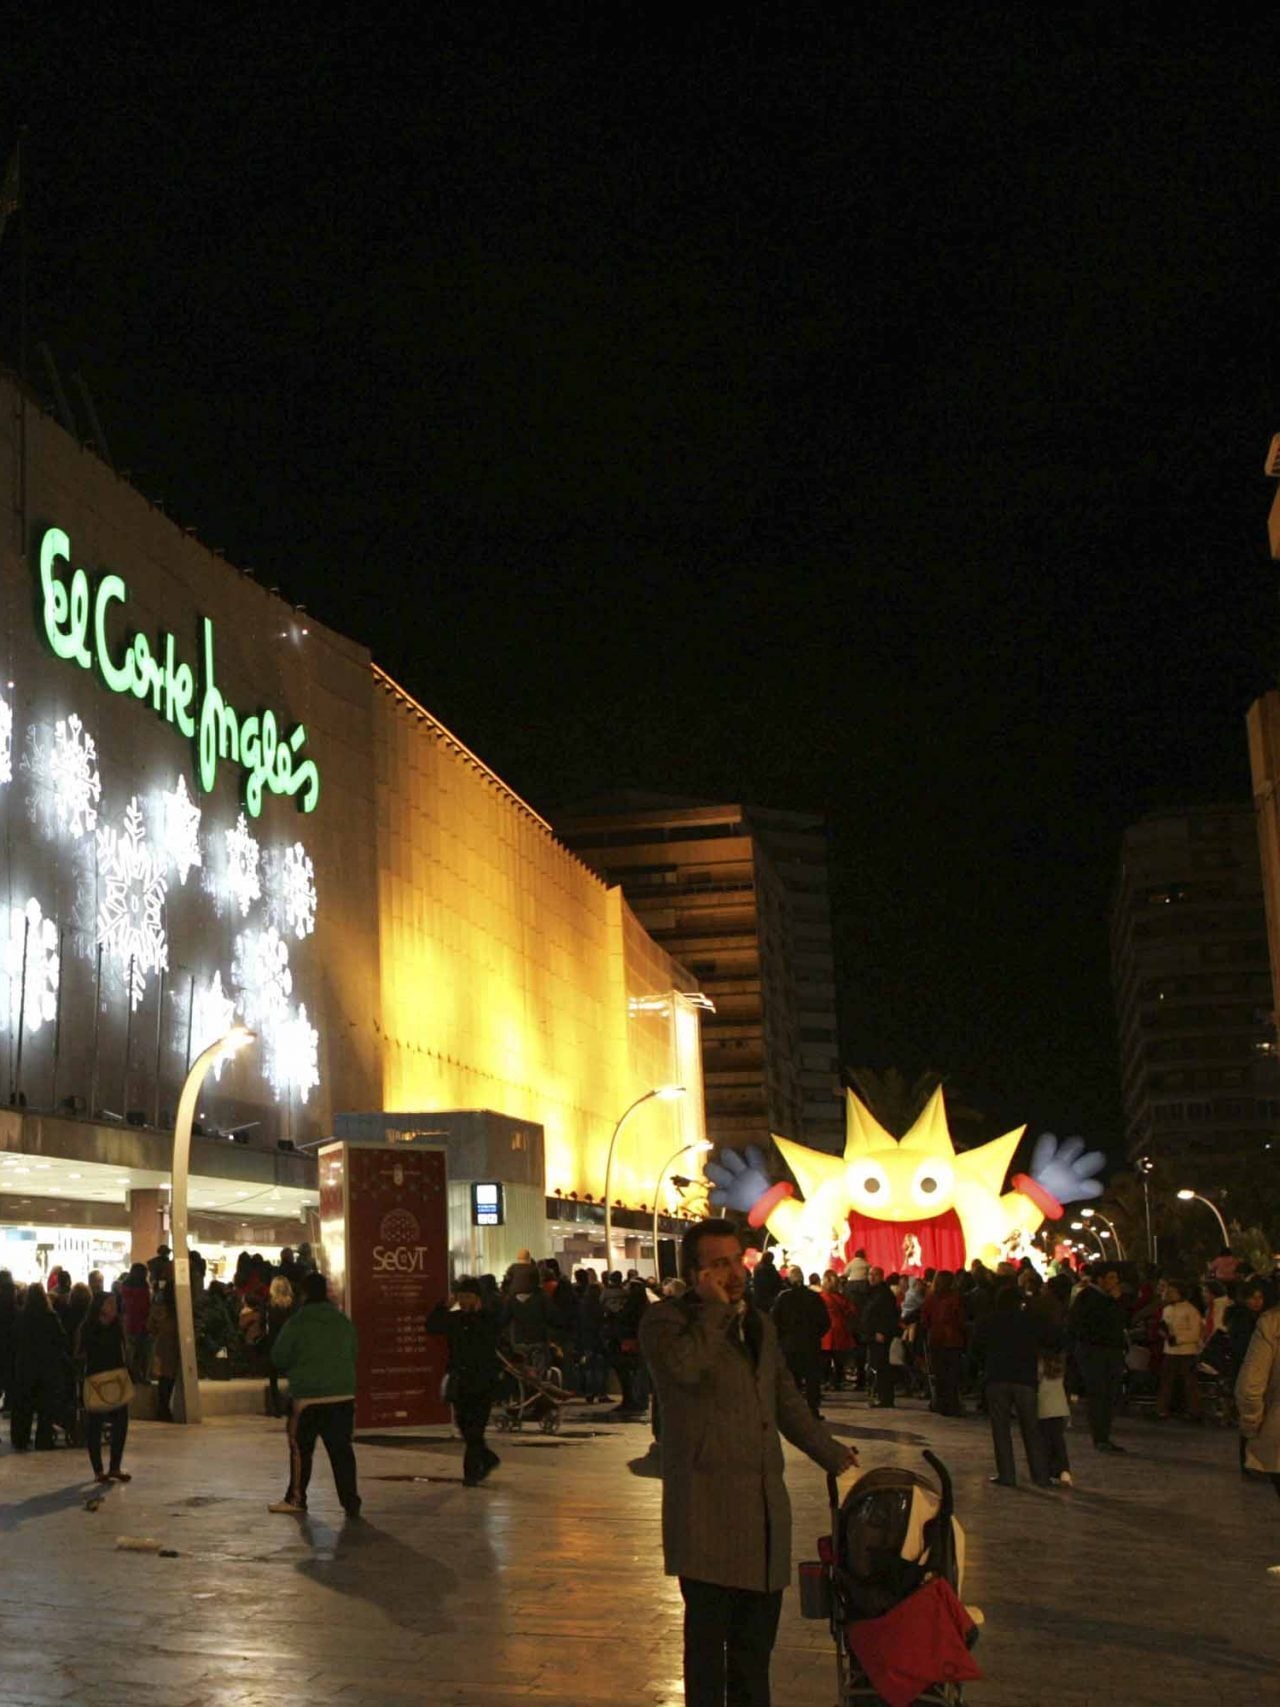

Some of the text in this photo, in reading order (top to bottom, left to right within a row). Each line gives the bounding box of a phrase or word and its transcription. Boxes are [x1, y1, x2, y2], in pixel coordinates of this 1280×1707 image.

[40, 527, 319, 818] El Corte Inglés
